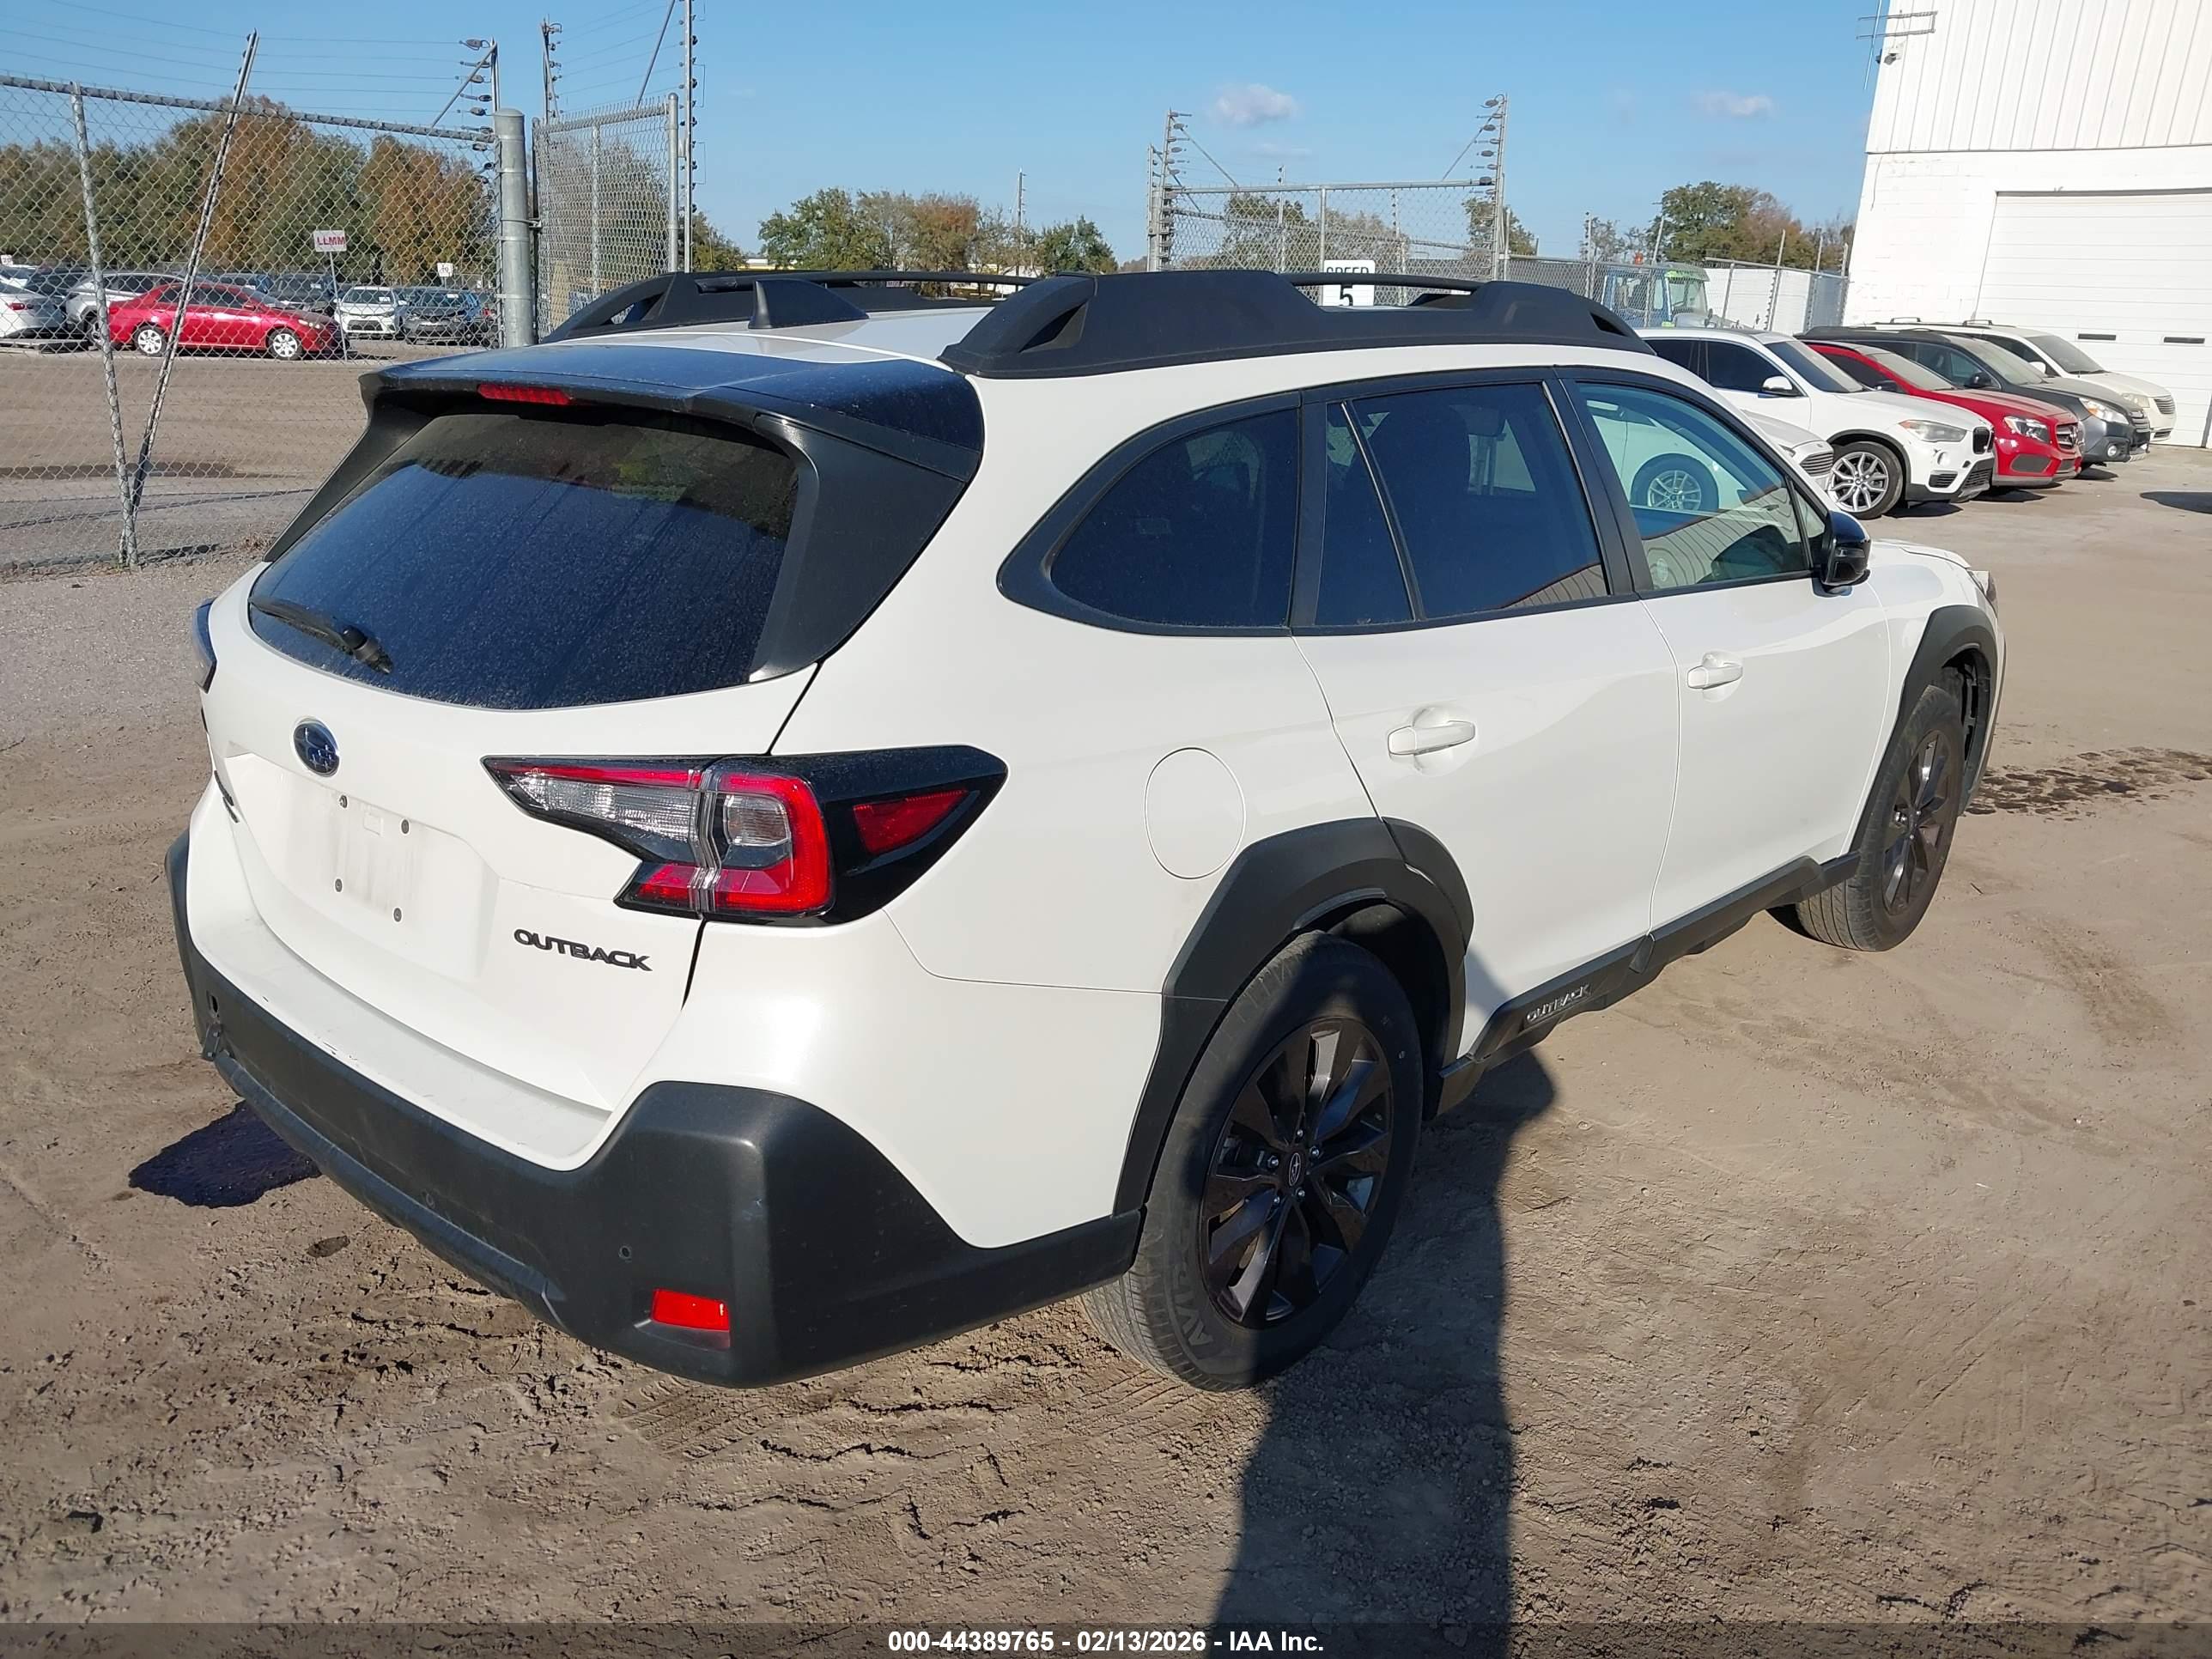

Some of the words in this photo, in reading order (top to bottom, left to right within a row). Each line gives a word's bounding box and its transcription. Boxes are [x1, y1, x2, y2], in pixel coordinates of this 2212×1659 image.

[317, 236, 345, 246] LLMM
[1339, 283, 1354, 307] 5
[514, 928, 653, 972] OUTBACK
[1526, 984, 1592, 1023] OUTBACK
